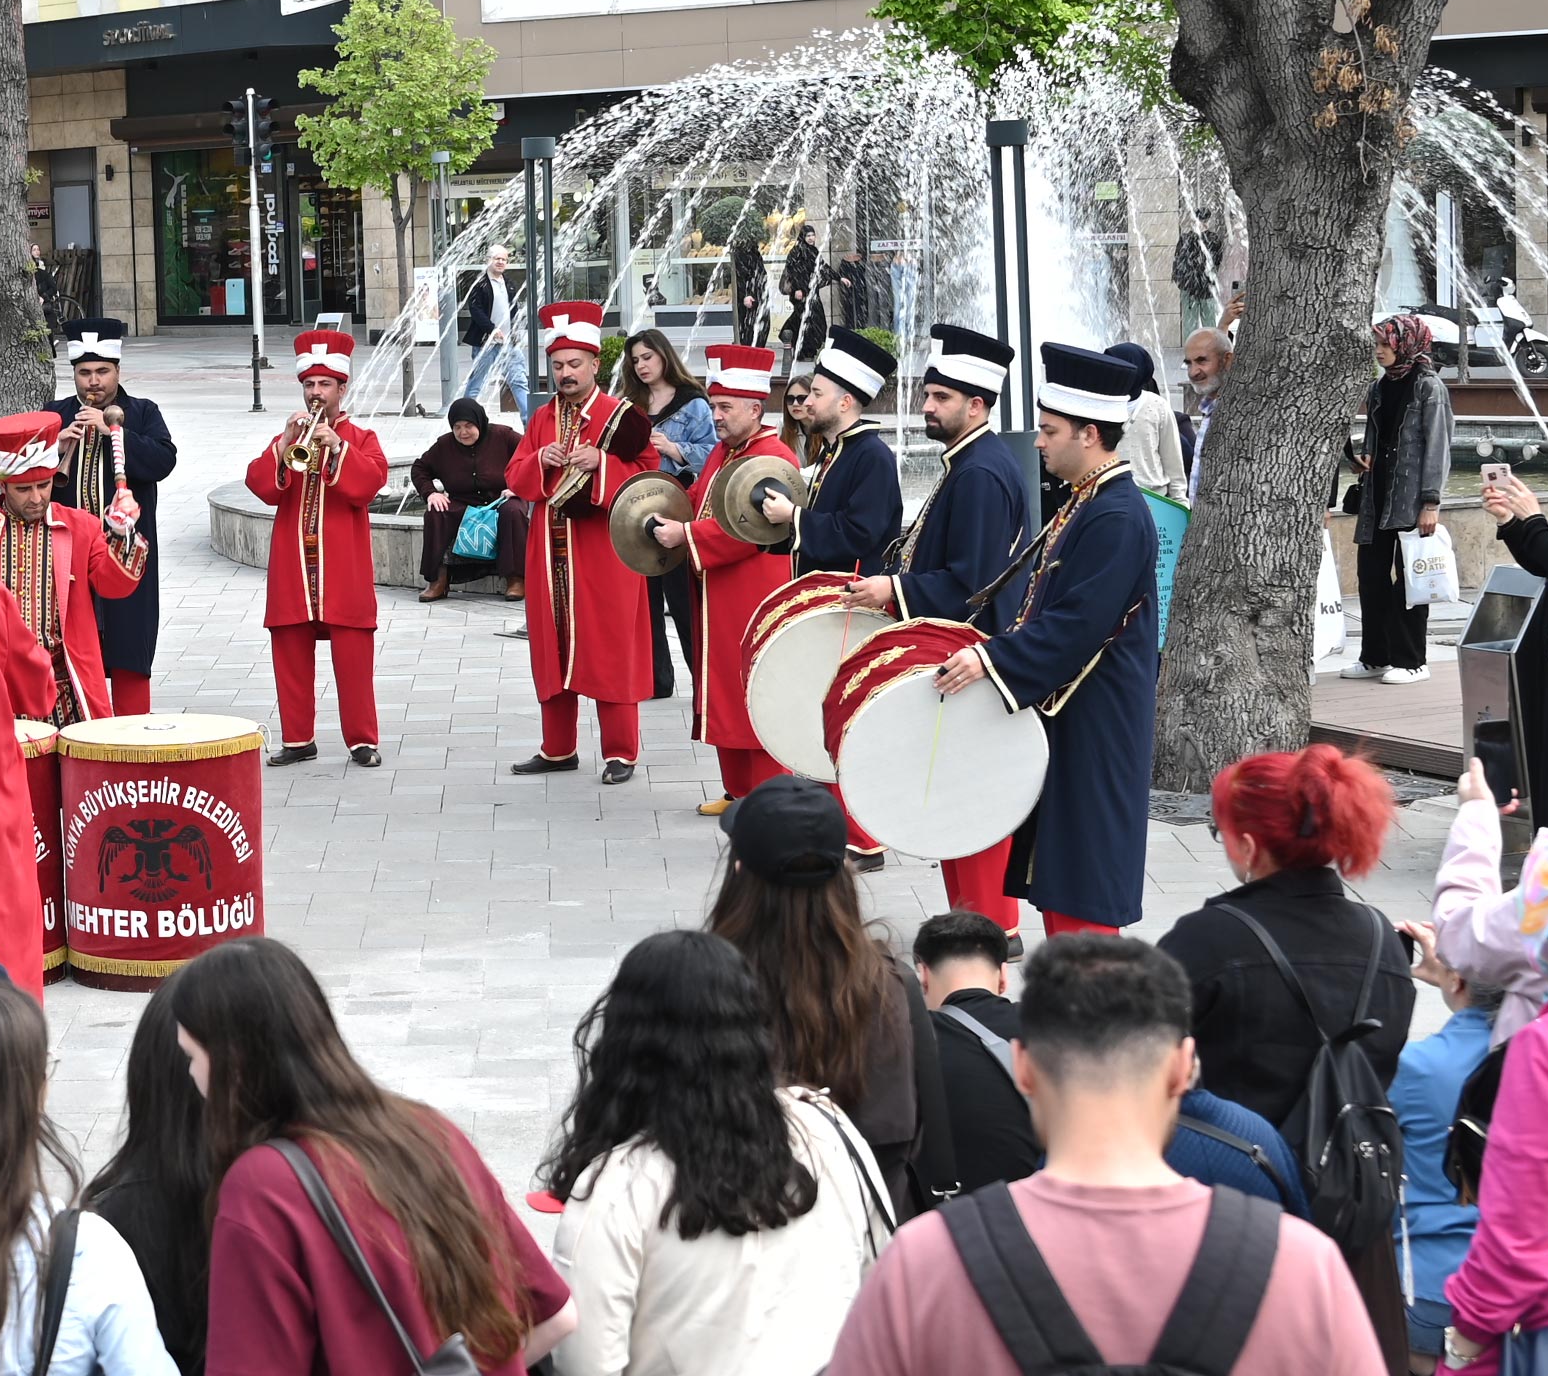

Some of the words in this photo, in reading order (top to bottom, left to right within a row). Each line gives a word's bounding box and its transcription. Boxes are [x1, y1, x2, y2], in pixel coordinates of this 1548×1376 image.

[64, 810, 86, 871] KONYA
[78, 776, 180, 824] BÜYÜKŞEHİR
[182, 784, 254, 865] BELEDİYESİ
[67, 901, 149, 938] MEHTER
[157, 891, 255, 938] BÖLÜĞÜ
